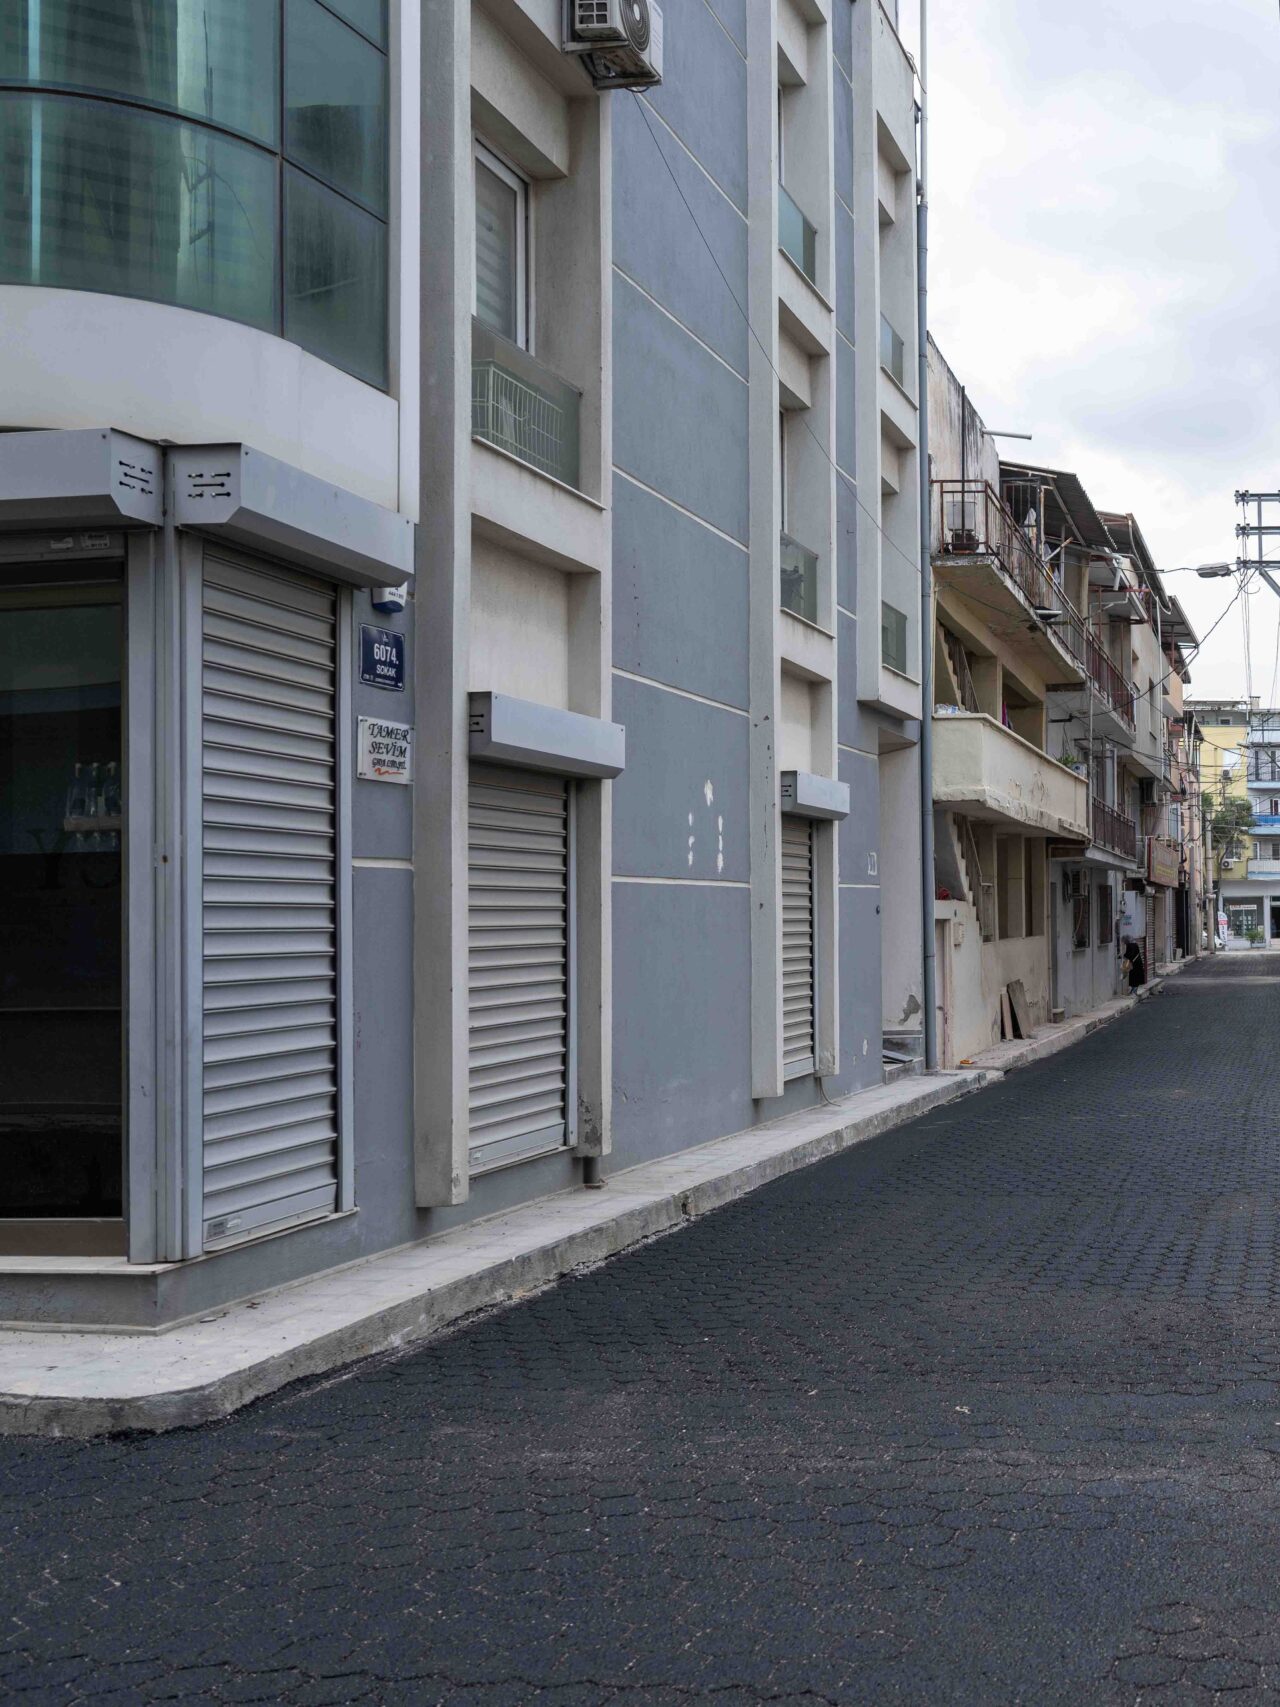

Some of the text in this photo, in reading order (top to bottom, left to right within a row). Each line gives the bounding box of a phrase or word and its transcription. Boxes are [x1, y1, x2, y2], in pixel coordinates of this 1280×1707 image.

[373, 643, 399, 665] 6074.
[376, 664, 397, 678] SOKAK
[368, 723, 411, 744] TAMER
[368, 741, 408, 759] SEVİM
